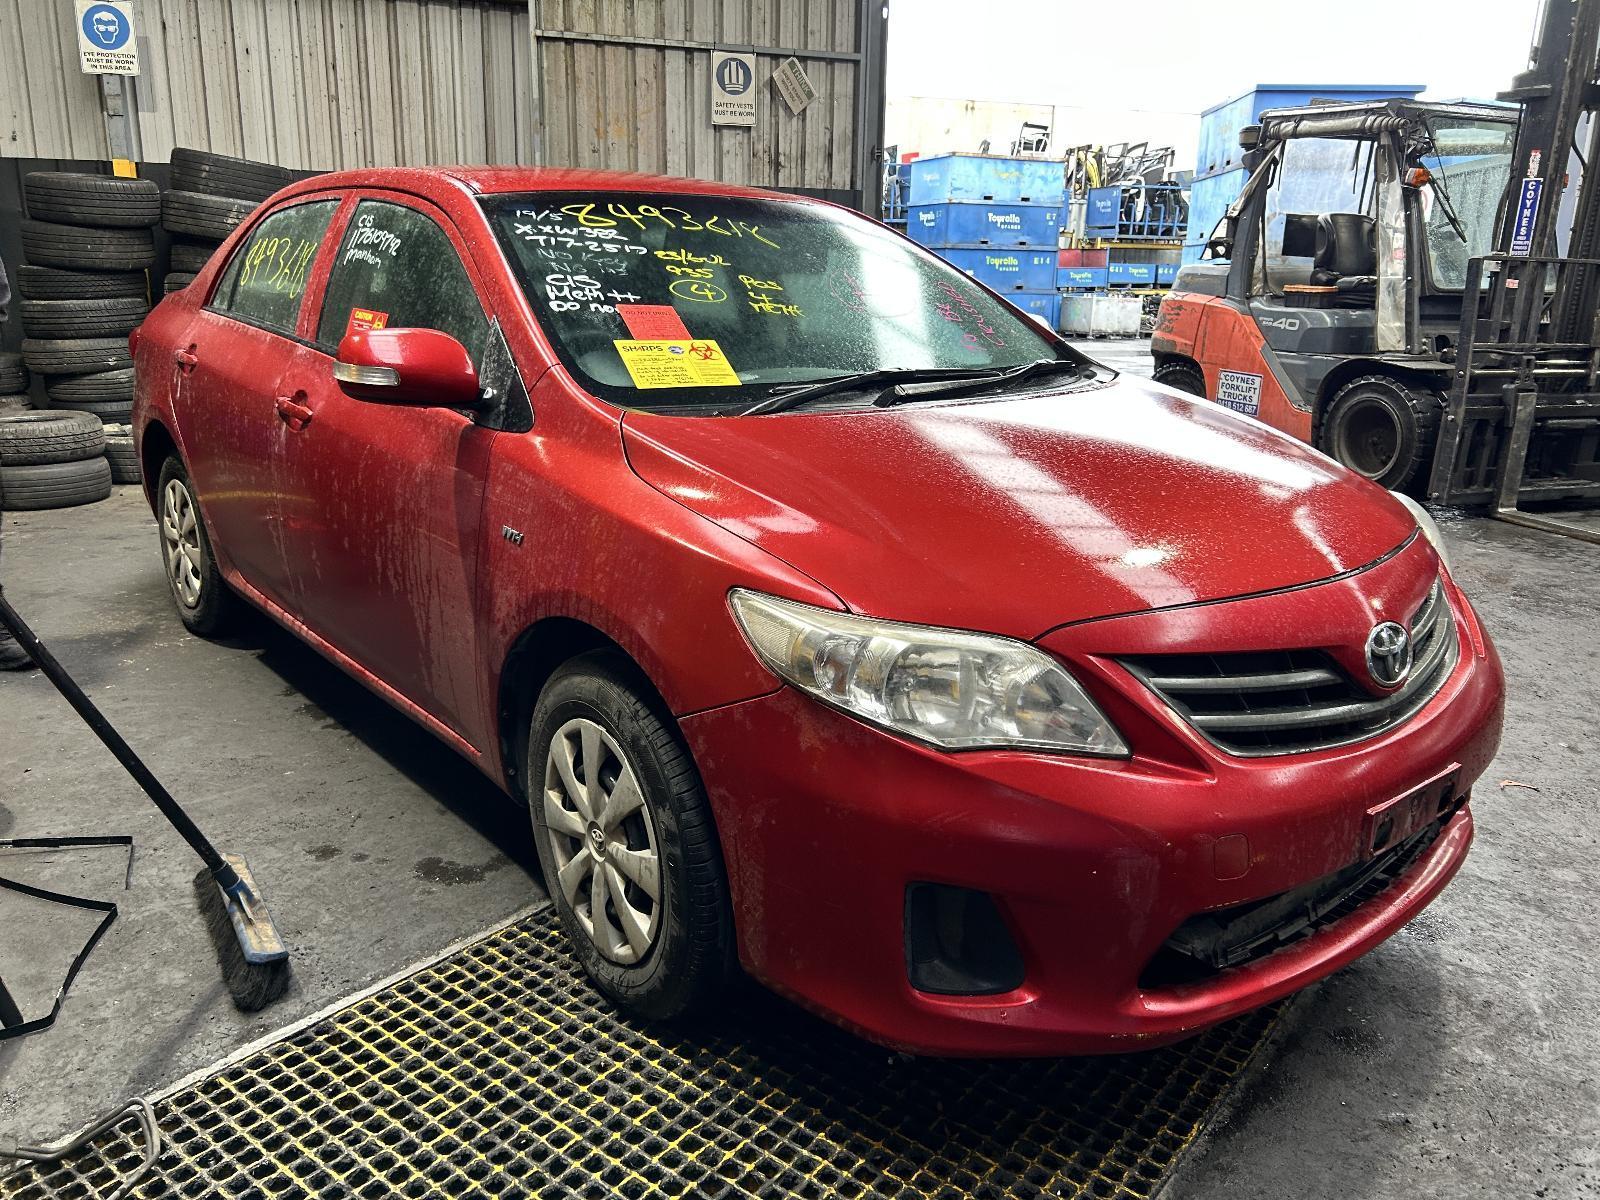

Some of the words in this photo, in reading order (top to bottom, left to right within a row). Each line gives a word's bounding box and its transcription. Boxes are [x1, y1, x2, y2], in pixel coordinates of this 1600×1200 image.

[792, 65, 811, 93] THINK
[1519, 181, 1537, 236] COYNES
[240, 237, 318, 299] 8493618
[1272, 317, 1300, 331] 40
[1223, 373, 1256, 386] COYNES
[1220, 381, 1258, 395] FORKLIFT
[1222, 390, 1254, 403] TRUCKS
[1232, 402, 1244, 413] 512
